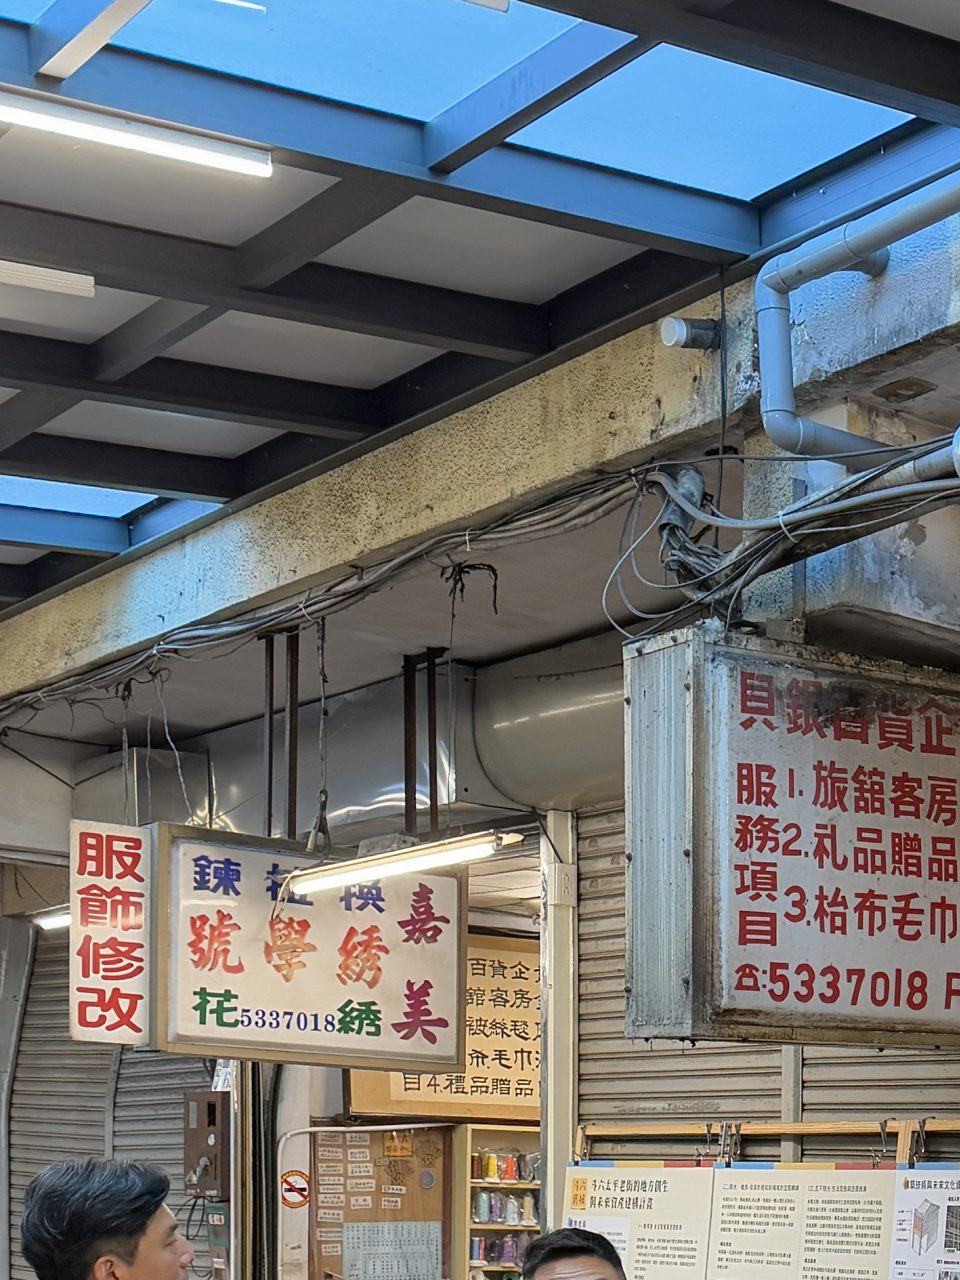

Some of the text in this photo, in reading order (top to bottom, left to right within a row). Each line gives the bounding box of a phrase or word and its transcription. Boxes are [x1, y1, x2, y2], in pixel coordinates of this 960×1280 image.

[76, 831, 145, 1034] 服飾修改
[734, 763, 780, 946] 服務項目
[240, 1008, 335, 1032] 5337018
